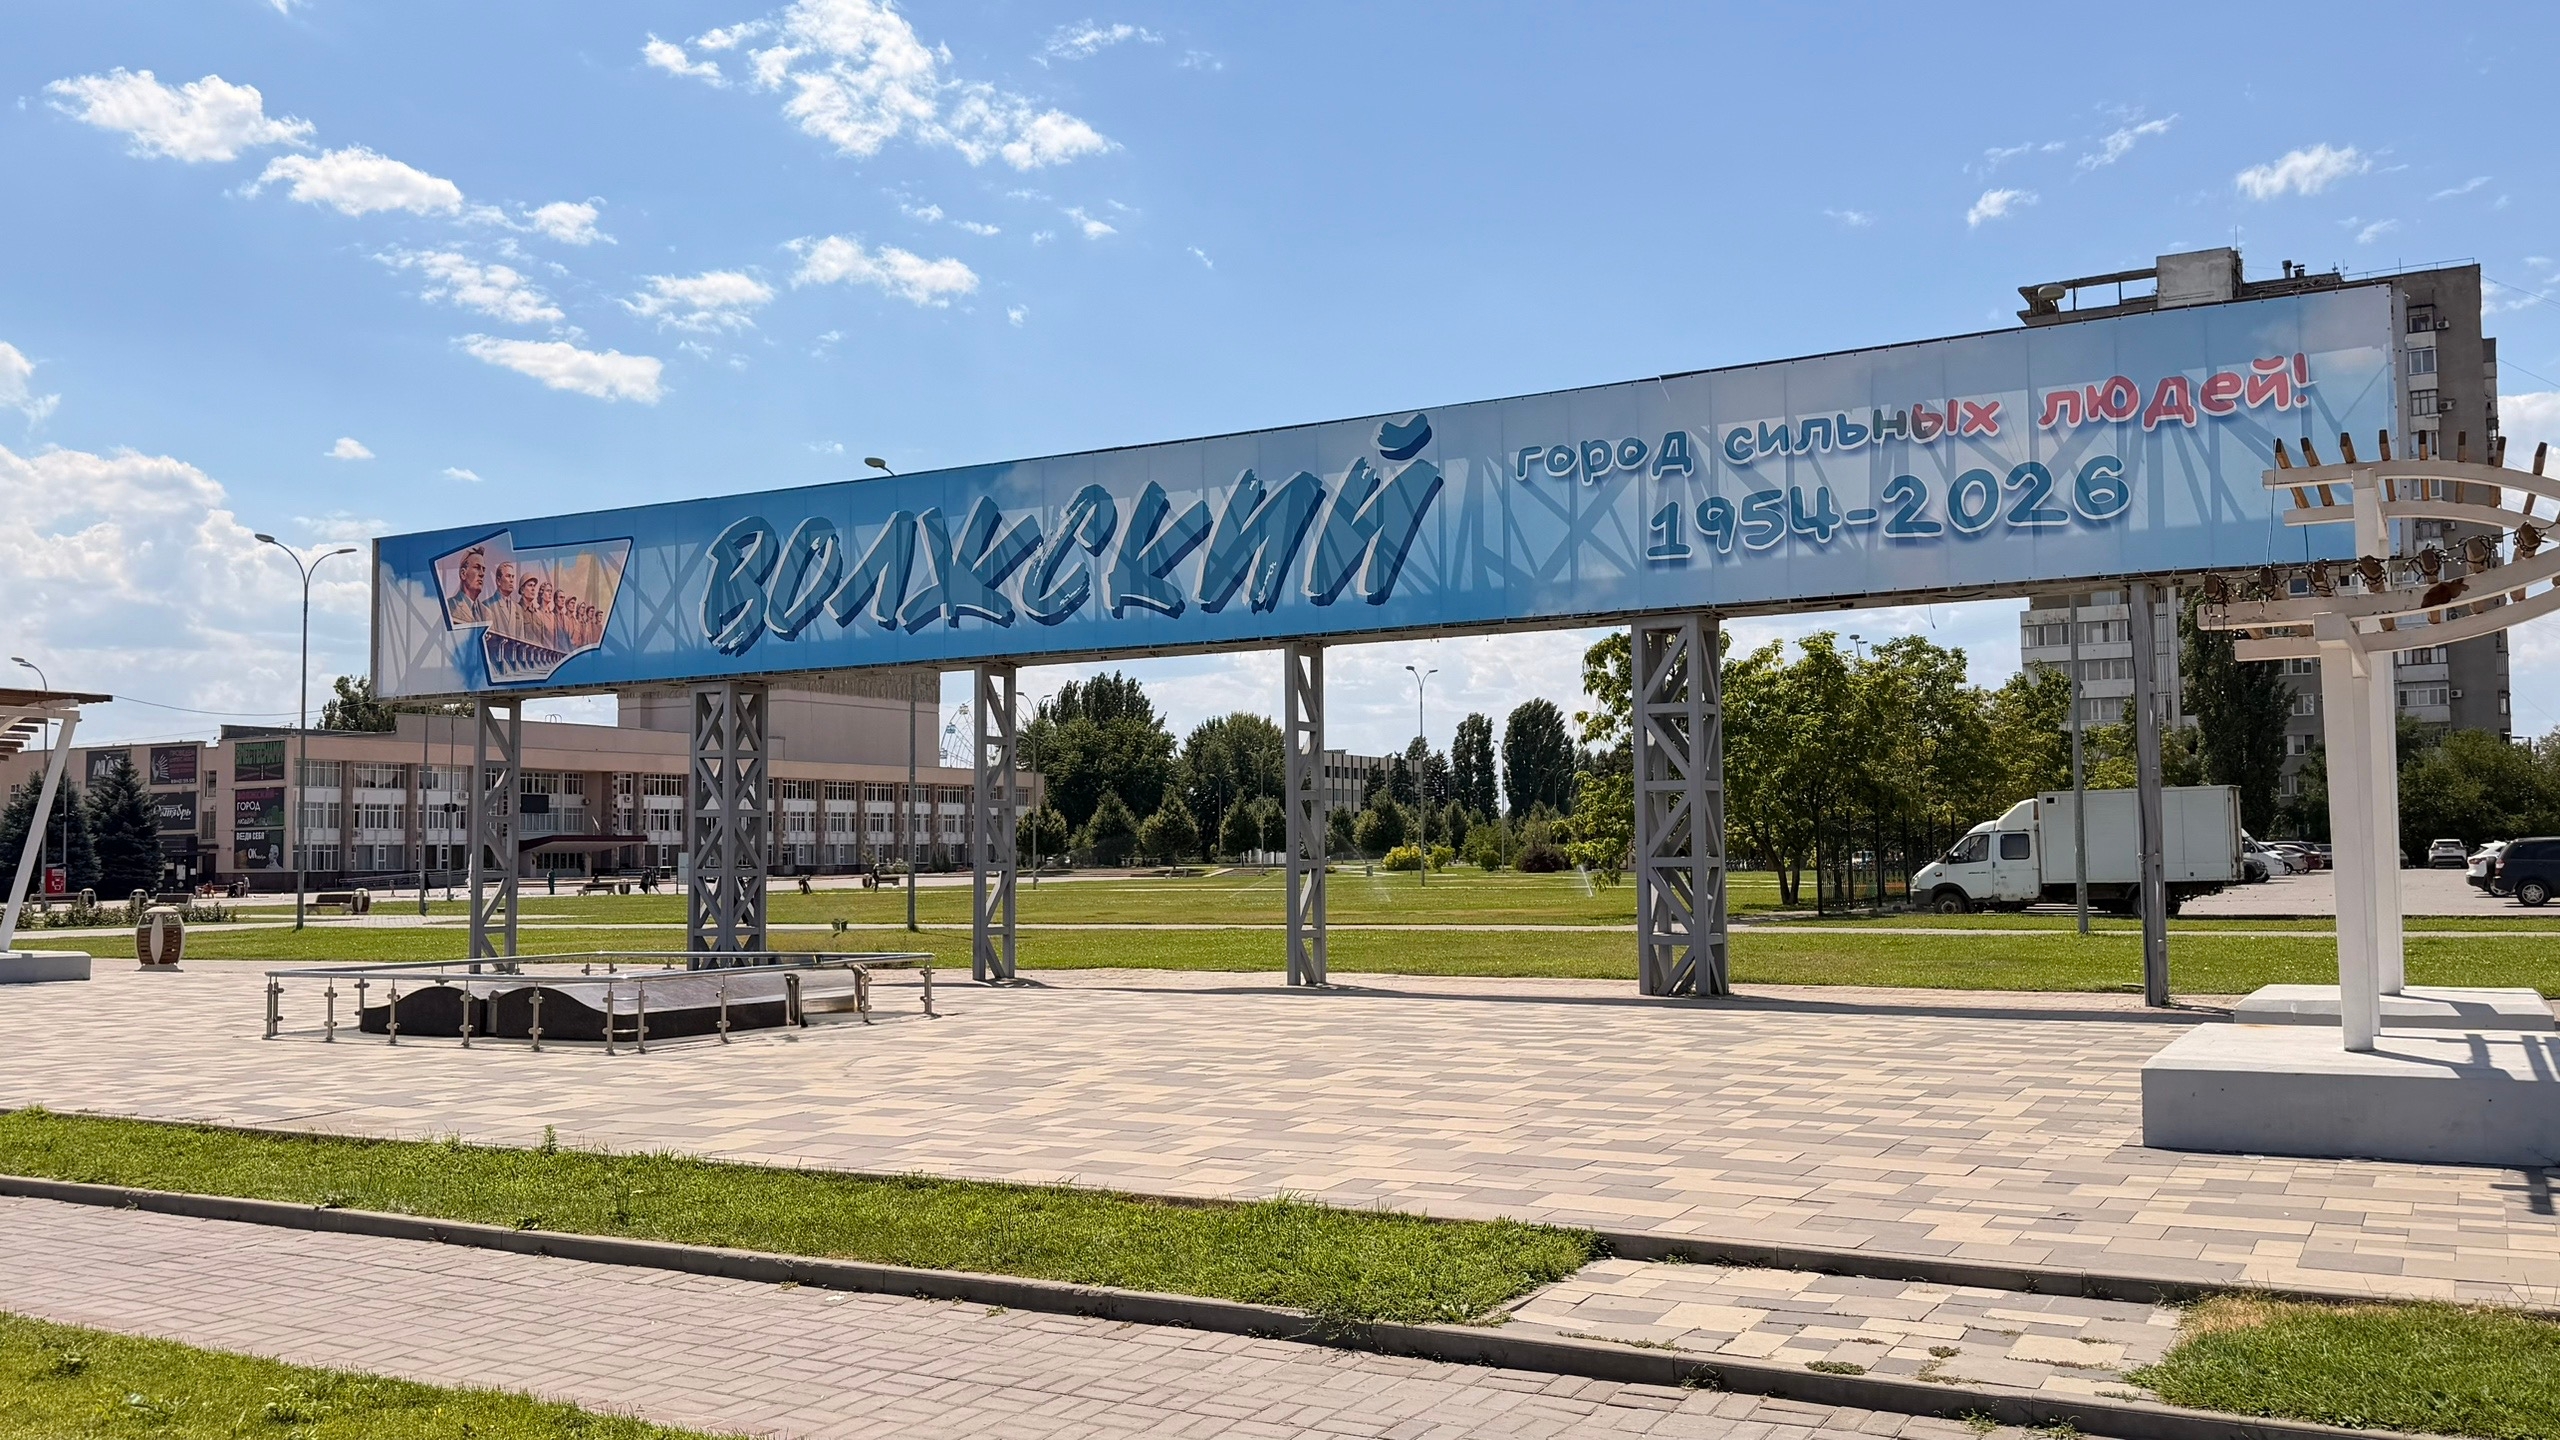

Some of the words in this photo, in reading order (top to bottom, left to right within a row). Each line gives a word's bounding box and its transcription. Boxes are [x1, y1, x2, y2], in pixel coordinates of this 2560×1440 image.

[1514, 429, 1693, 487] город
[1724, 397, 2001, 462] сильных
[2036, 352, 2314, 433] людей!
[700, 413, 1443, 656] ВОЛЖСКИЙ
[1646, 454, 2129, 561] 1954-2026
[236, 801, 261, 811] ГОРОД
